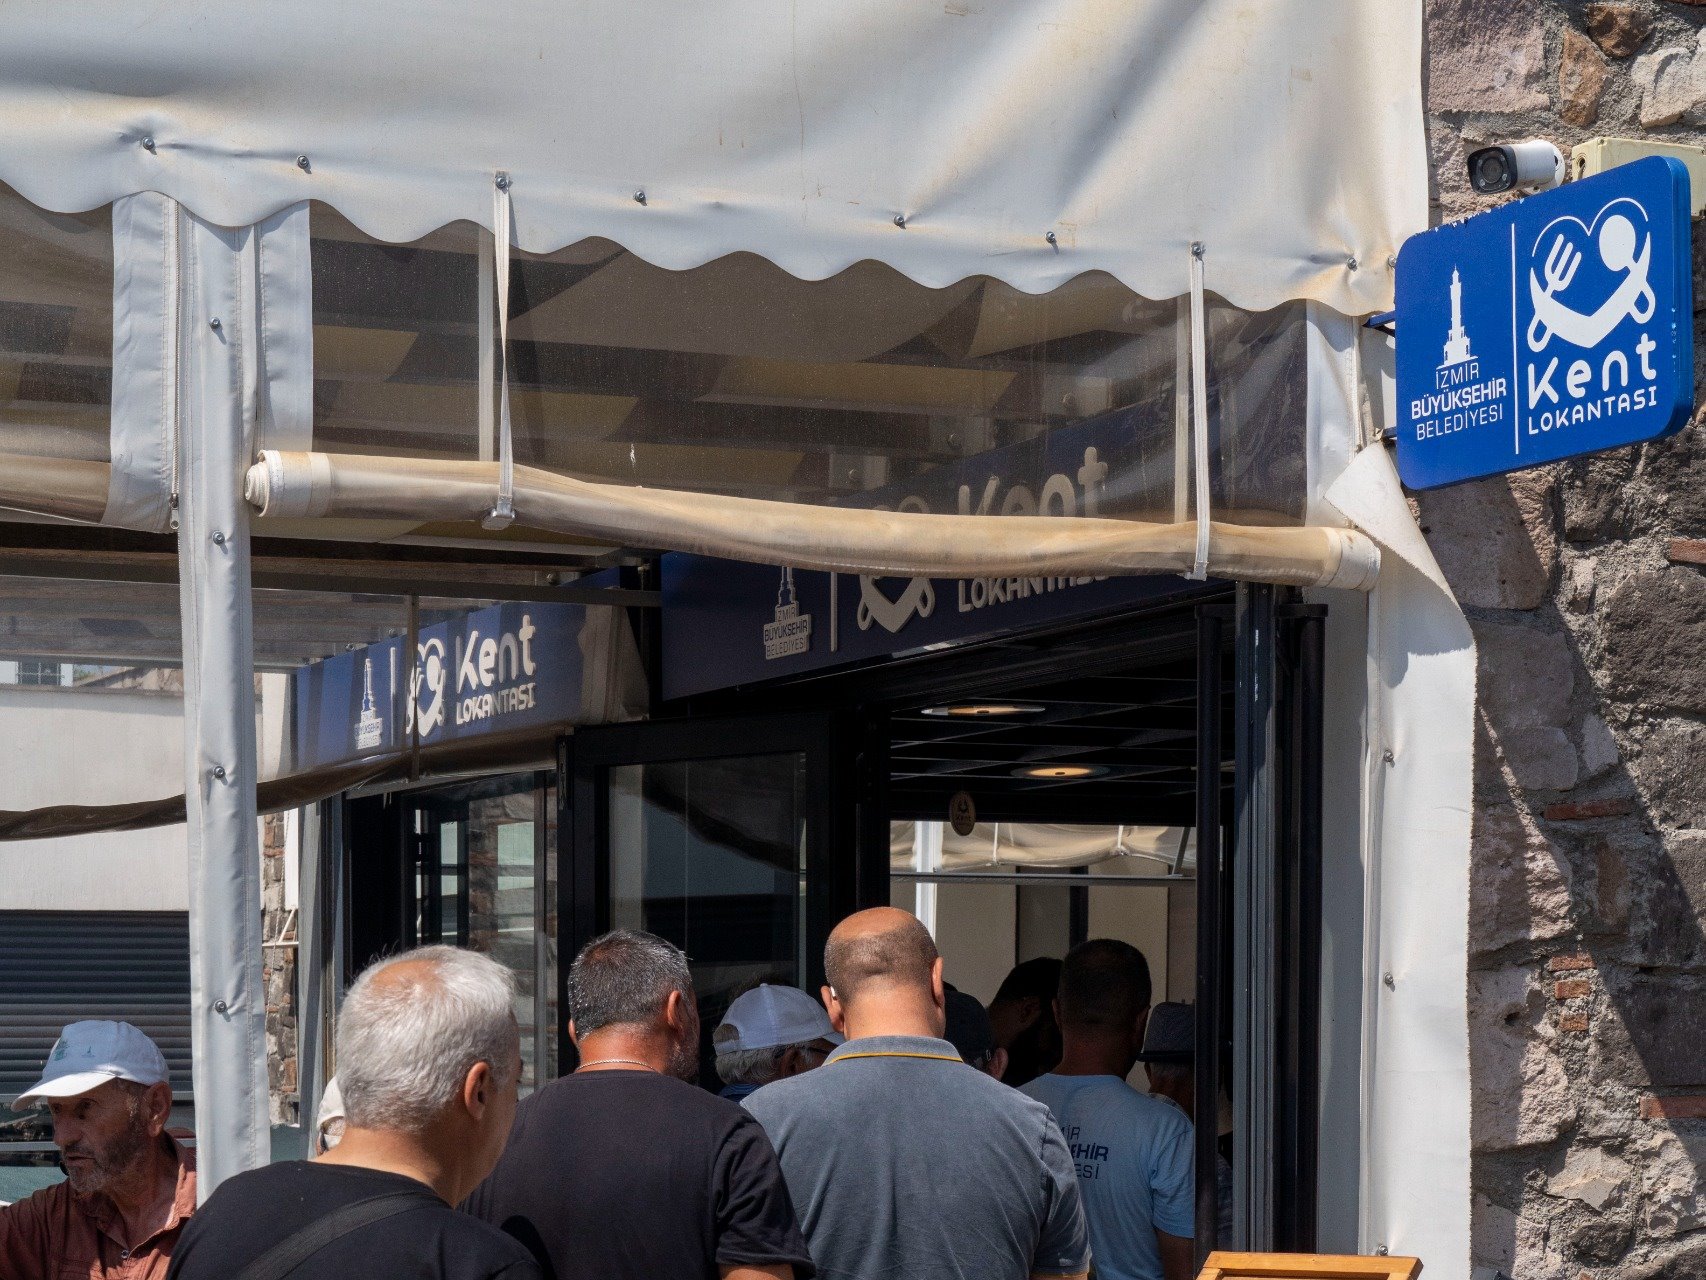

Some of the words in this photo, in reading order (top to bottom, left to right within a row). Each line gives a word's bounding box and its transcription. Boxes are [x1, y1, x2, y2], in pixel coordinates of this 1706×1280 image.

[1435, 361, 1479, 390] İZMİR
[1528, 333, 1657, 410] Kent
[1411, 377, 1507, 420] BÜYÜKŞEHİR
[1528, 385, 1658, 436] LOKANTASI
[456, 614, 536, 694] Kent
[456, 682, 537, 726] LOKANTASI
